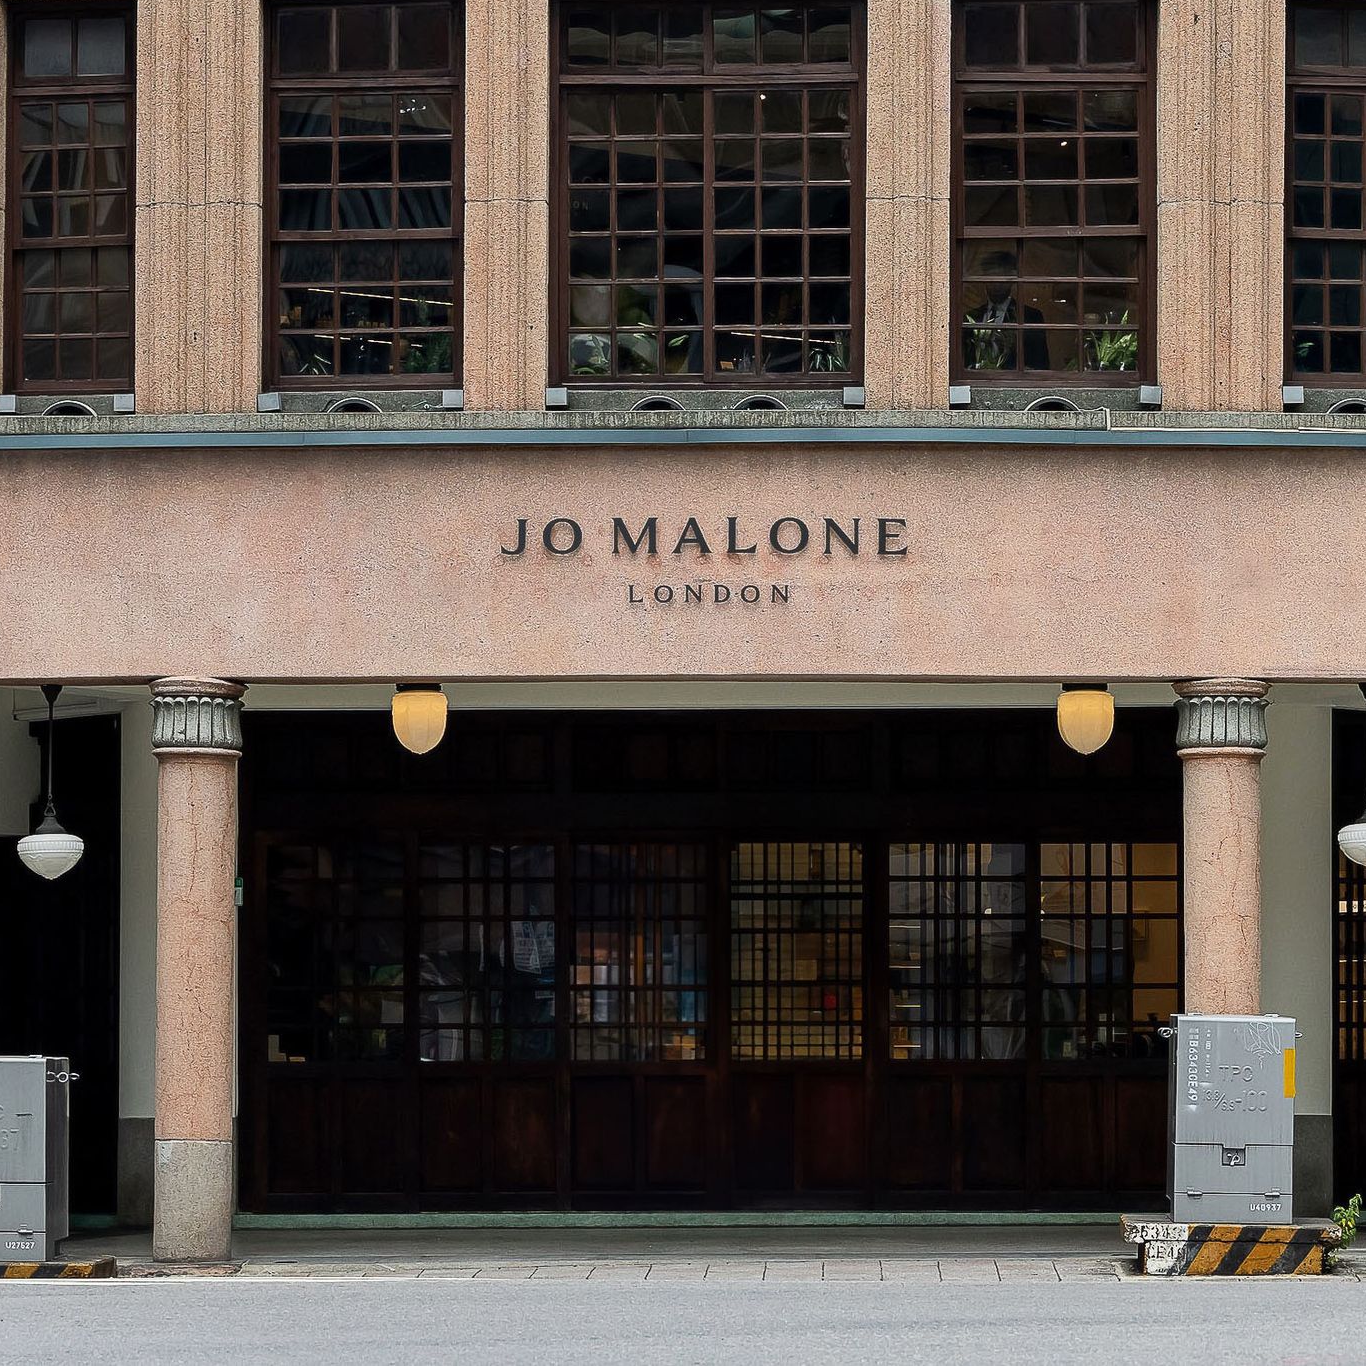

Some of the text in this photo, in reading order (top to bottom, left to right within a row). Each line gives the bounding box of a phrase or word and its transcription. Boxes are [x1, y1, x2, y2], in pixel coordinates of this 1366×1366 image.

[500, 517, 908, 556] JO MALONE
[628, 585, 791, 605] LONDON
